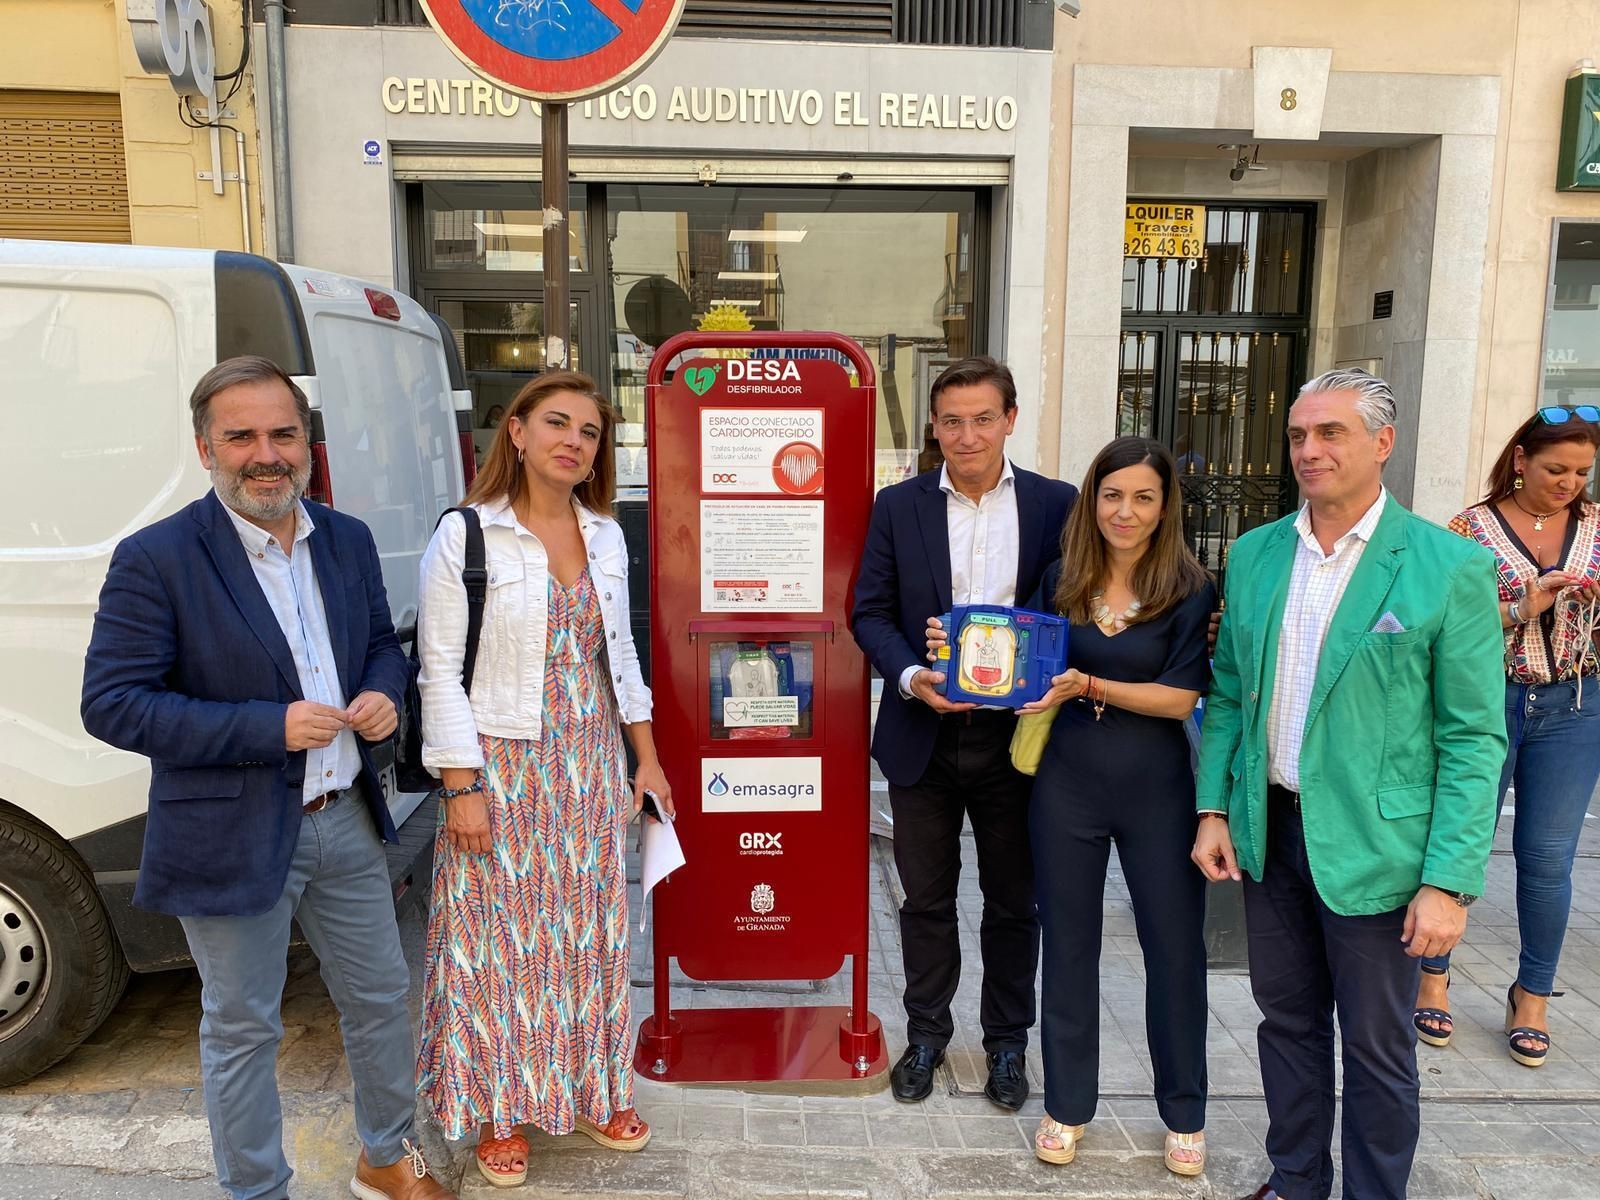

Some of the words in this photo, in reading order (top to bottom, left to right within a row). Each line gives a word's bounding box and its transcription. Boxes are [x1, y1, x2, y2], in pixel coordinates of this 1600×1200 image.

[381, 76, 520, 117] CENTRO
[666, 86, 824, 125] AUDITIVO
[834, 91, 869, 126] EL
[879, 92, 1018, 131] REALEJO
[1279, 88, 1297, 111] 8
[1125, 206, 1194, 221] LQUILER
[1131, 237, 1151, 256] 26
[1156, 238, 1176, 256] 43
[1181, 238, 1200, 257] 63
[727, 359, 802, 381] DESA
[727, 385, 802, 394] DESFIBRILADOR
[709, 416, 750, 426] ESPACIO
[751, 417, 815, 427] CONECTADO
[709, 427, 815, 438] CARDIOPROTEGIDO
[712, 473, 737, 483] DOC
[732, 783, 815, 799] emasagra
[739, 832, 783, 849] GRX
[733, 915, 791, 923] AYUNTAMIENTO
[745, 923, 786, 931] GRANADA
